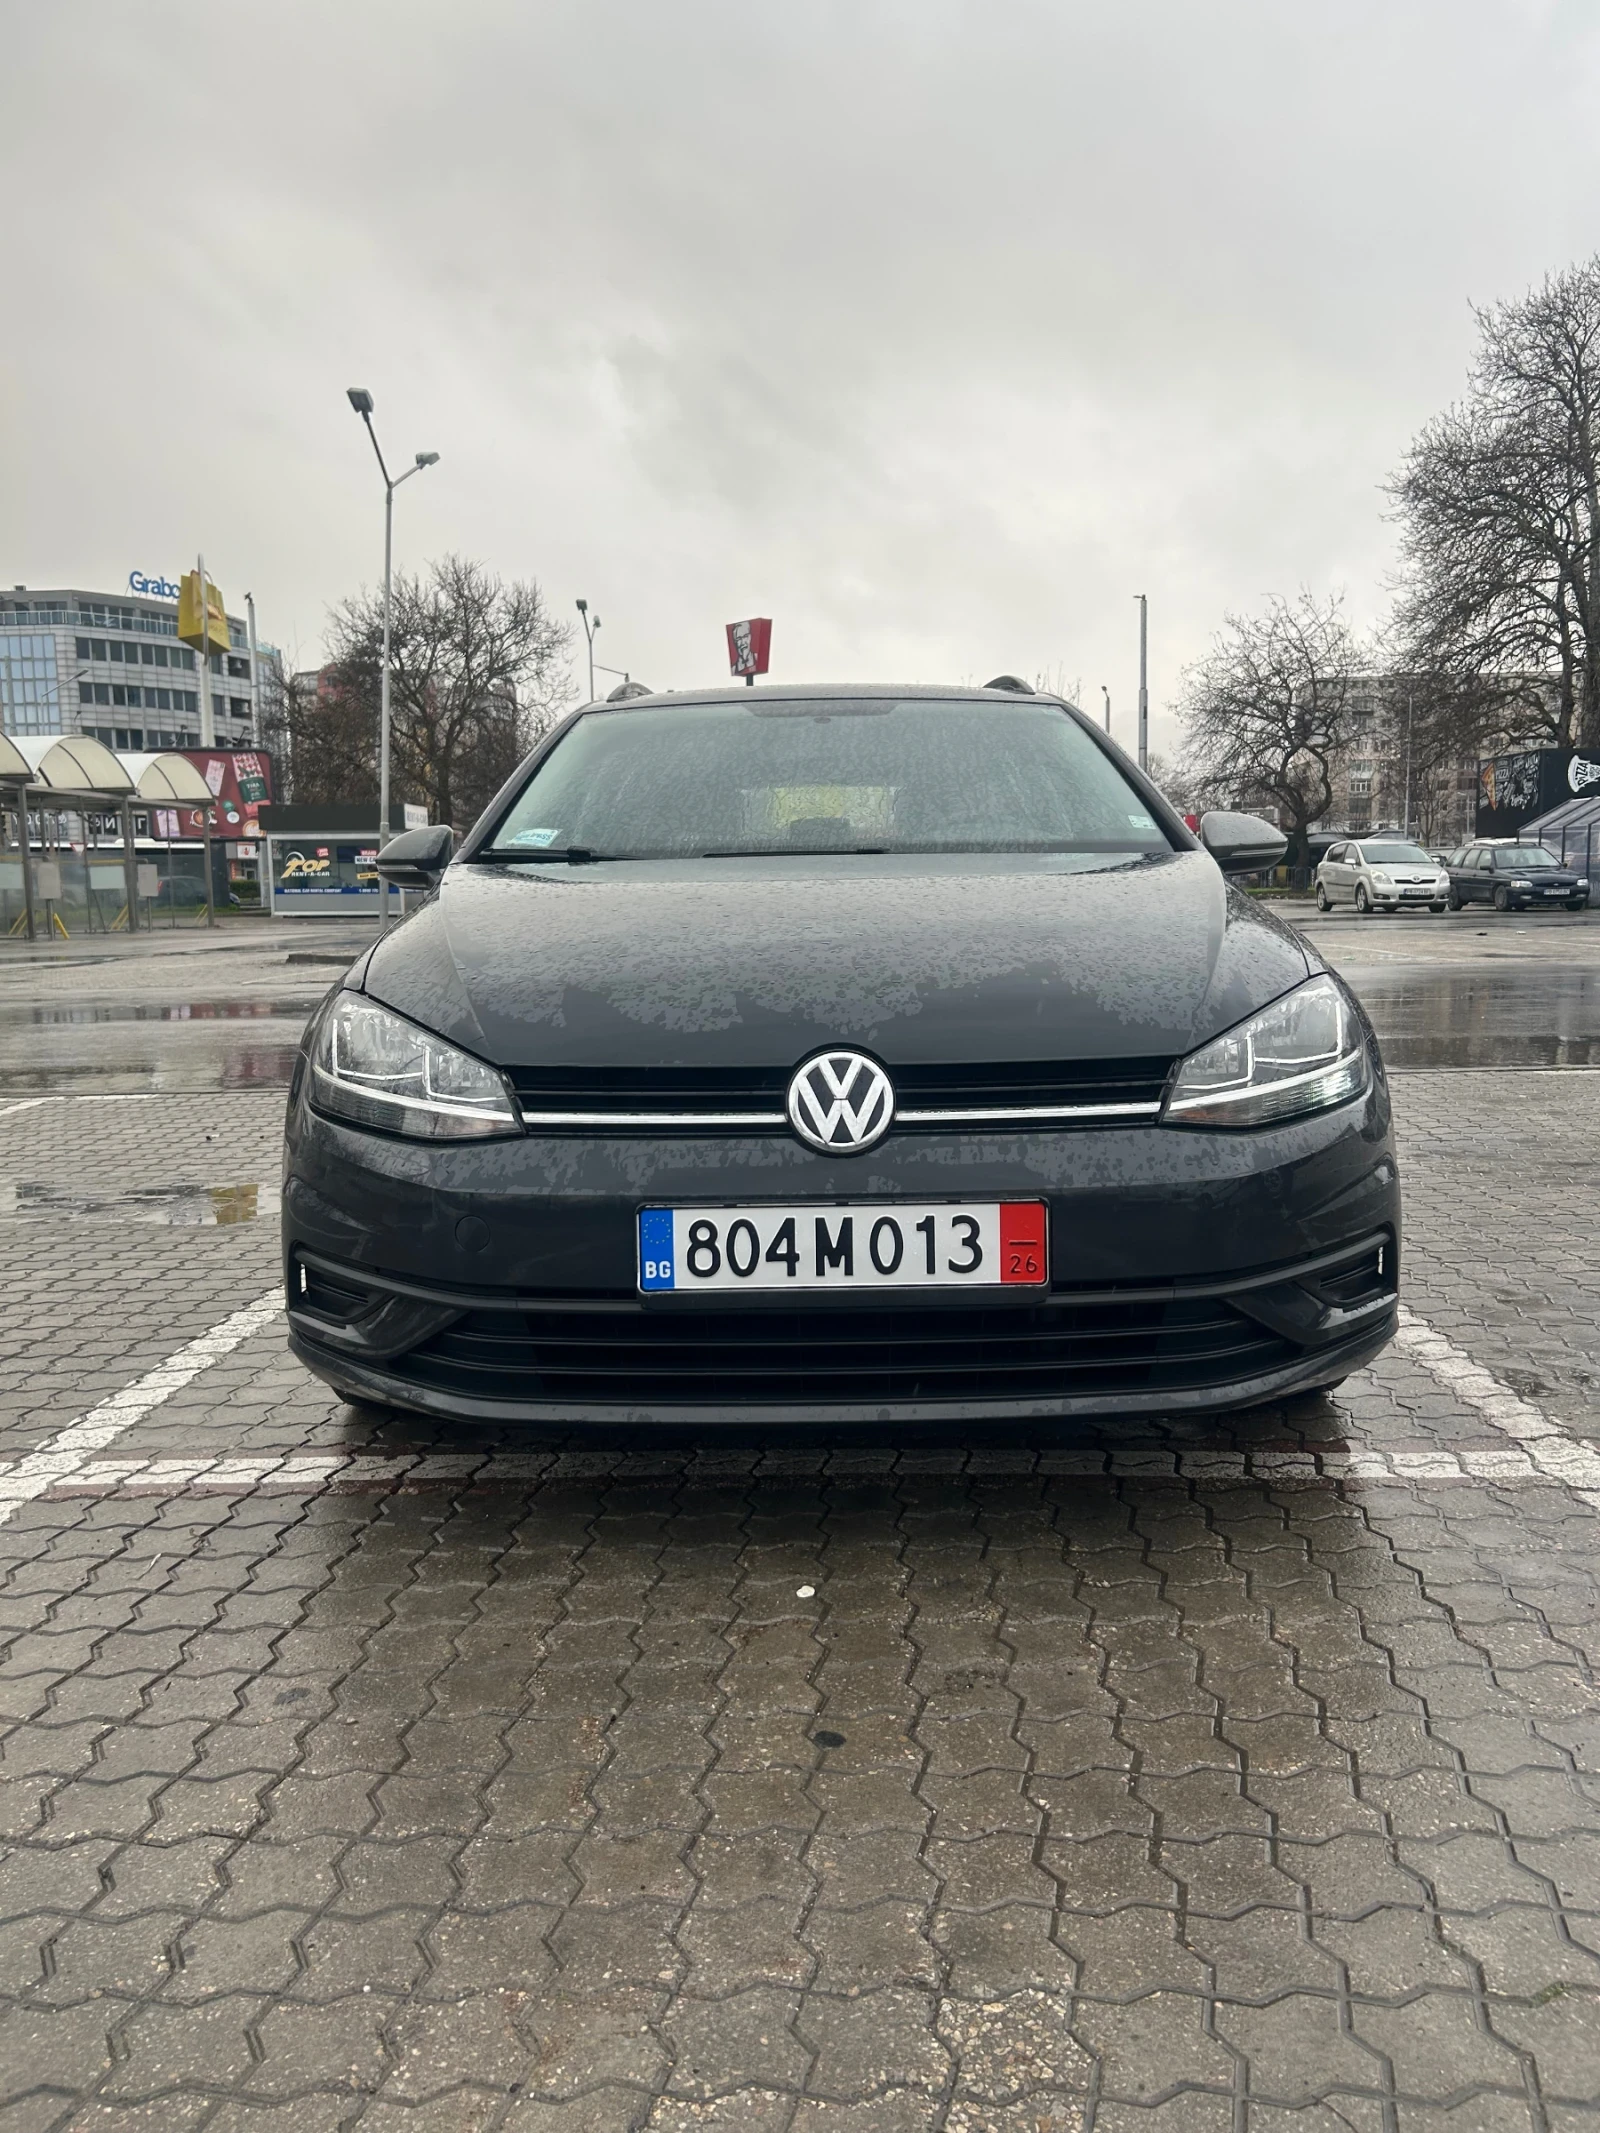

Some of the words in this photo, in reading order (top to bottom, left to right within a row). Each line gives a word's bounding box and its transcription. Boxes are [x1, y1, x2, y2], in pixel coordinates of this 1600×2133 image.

[129, 570, 181, 599] Grabo
[281, 859, 330, 879] TOP
[645, 1260, 671, 1278] BG
[1010, 1253, 1037, 1274] 26
